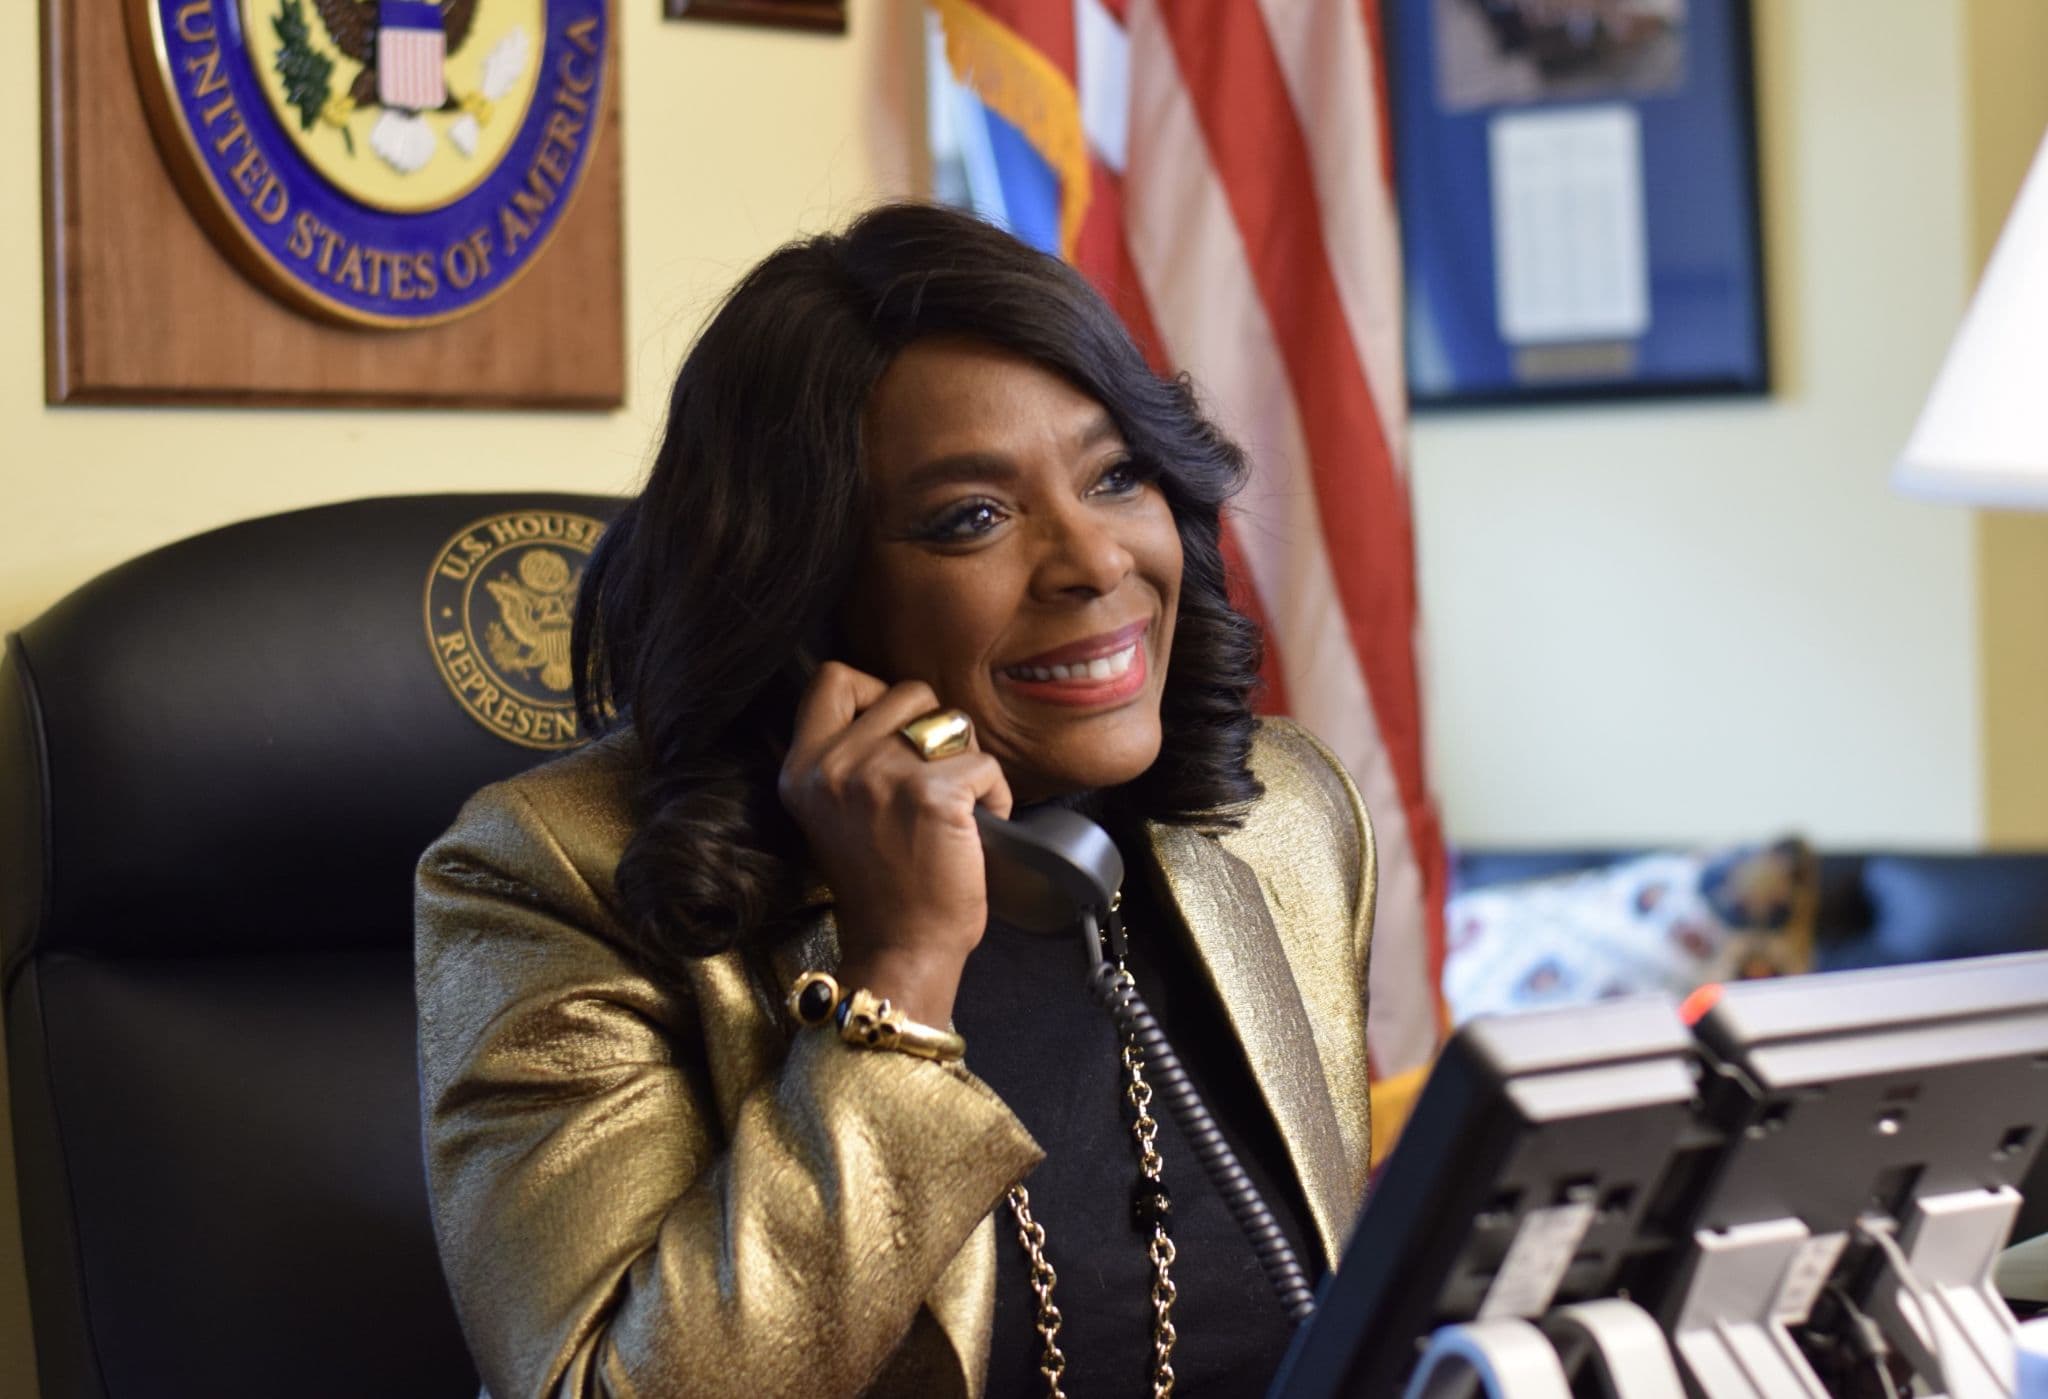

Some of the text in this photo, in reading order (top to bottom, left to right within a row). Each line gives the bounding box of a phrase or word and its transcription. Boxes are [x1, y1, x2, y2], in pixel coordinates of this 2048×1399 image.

[177, 2, 598, 299] UNITED STATES OF AMERICA
[440, 535, 492, 580] U.S.
[438, 631, 577, 741] REPRESEN
